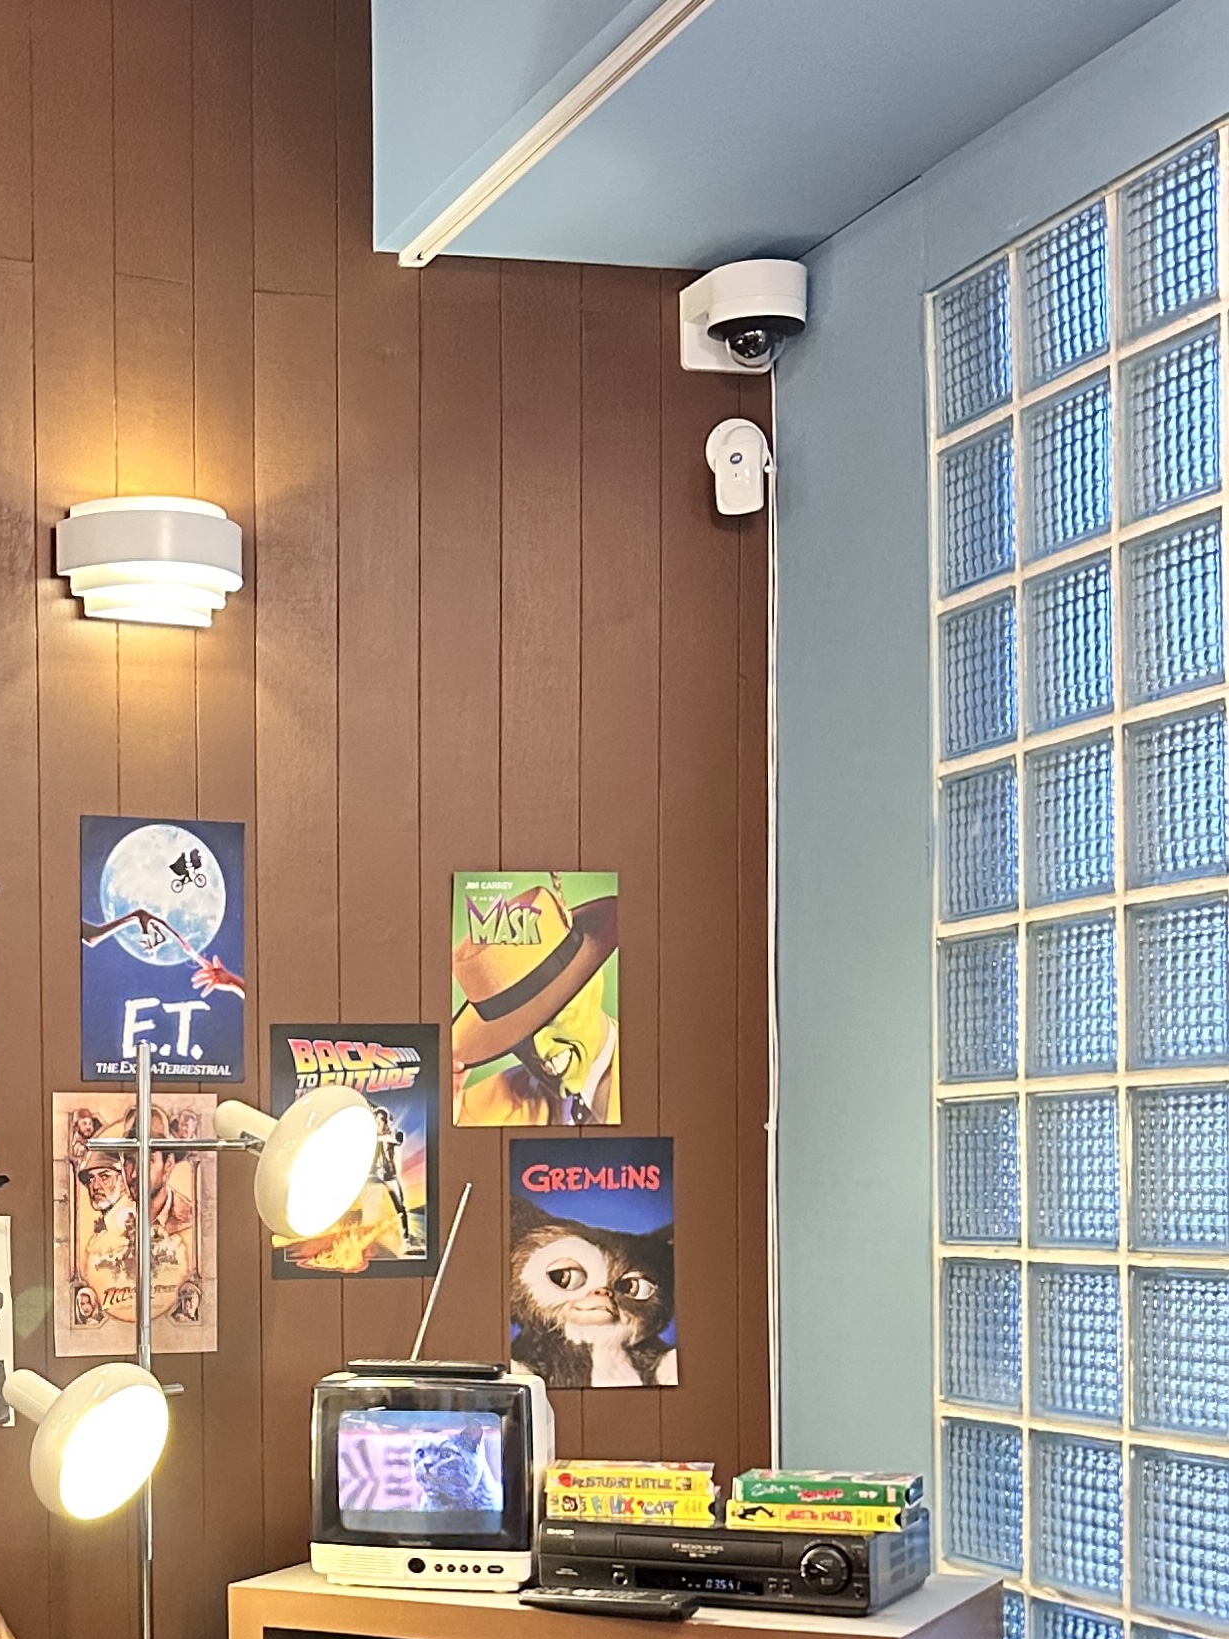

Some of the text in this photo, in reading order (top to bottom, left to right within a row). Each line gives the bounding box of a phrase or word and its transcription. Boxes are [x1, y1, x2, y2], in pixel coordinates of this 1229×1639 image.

[465, 892, 542, 946] MASK
[122, 997, 211, 1060] E.T.
[96, 1061, 232, 1076] THE EXA-TERRESTRIAL
[288, 1039, 406, 1073] BACK
[296, 1067, 421, 1093] TO FUTURE
[522, 1164, 661, 1193] GREMLINS
[635, 1477, 672, 1490] LITTLE
